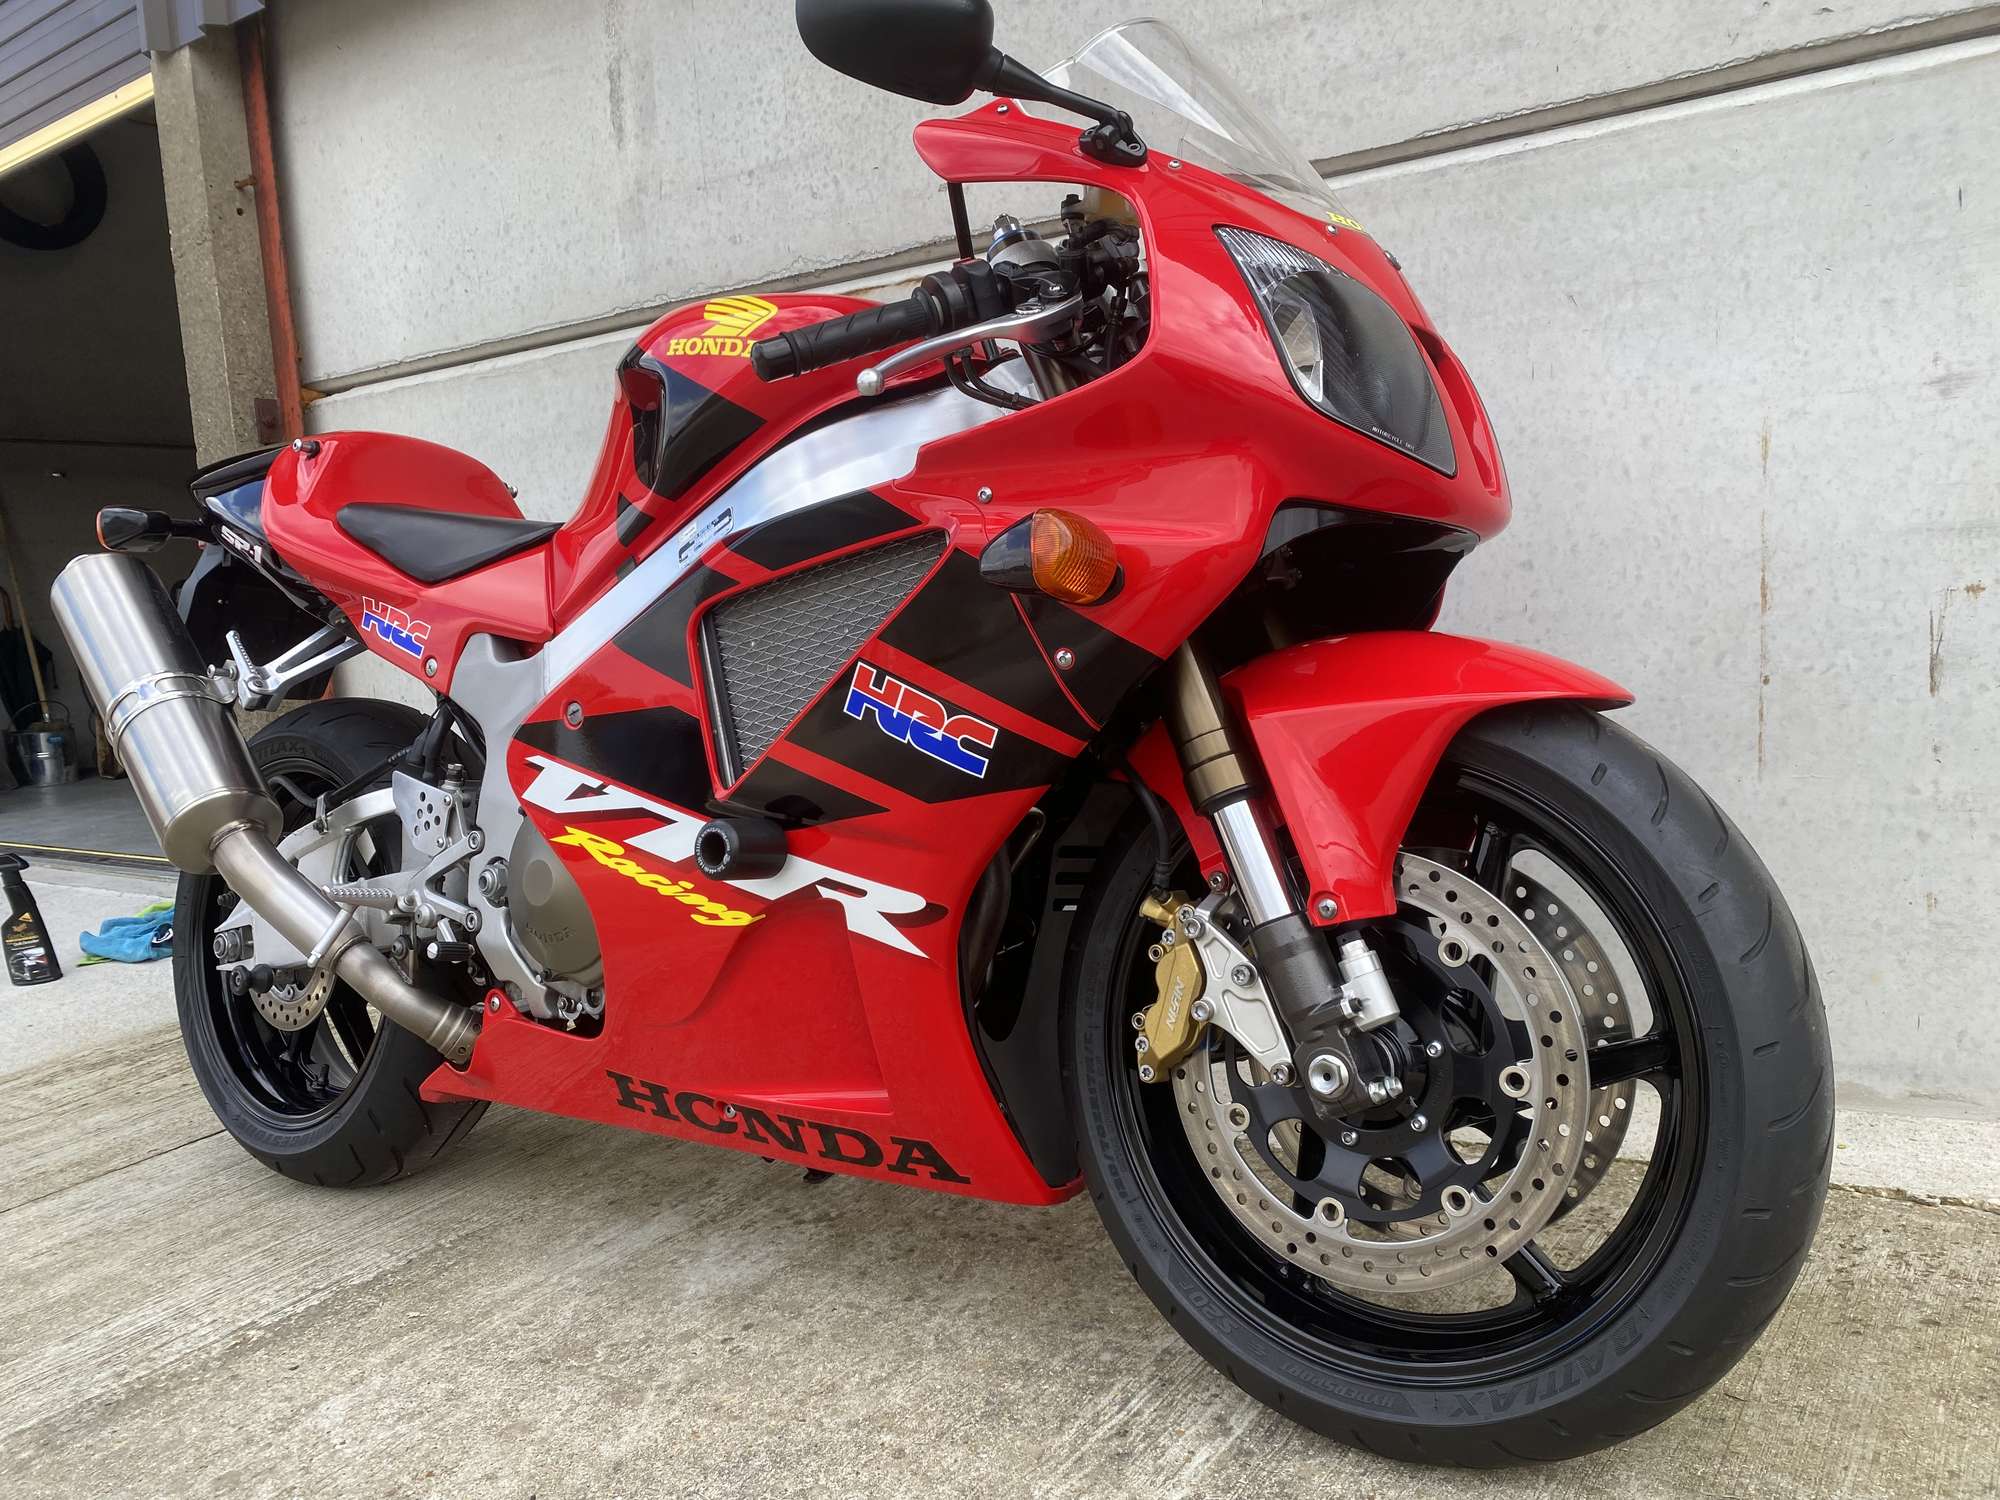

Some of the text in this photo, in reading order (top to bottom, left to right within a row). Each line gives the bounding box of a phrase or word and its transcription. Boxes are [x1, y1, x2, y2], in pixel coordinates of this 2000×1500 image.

[361, 595, 431, 659] HRC
[843, 661, 998, 779] HRC
[521, 755, 930, 959] VTR
[551, 825, 766, 926] Racing
[605, 1070, 972, 1184] HONDA
